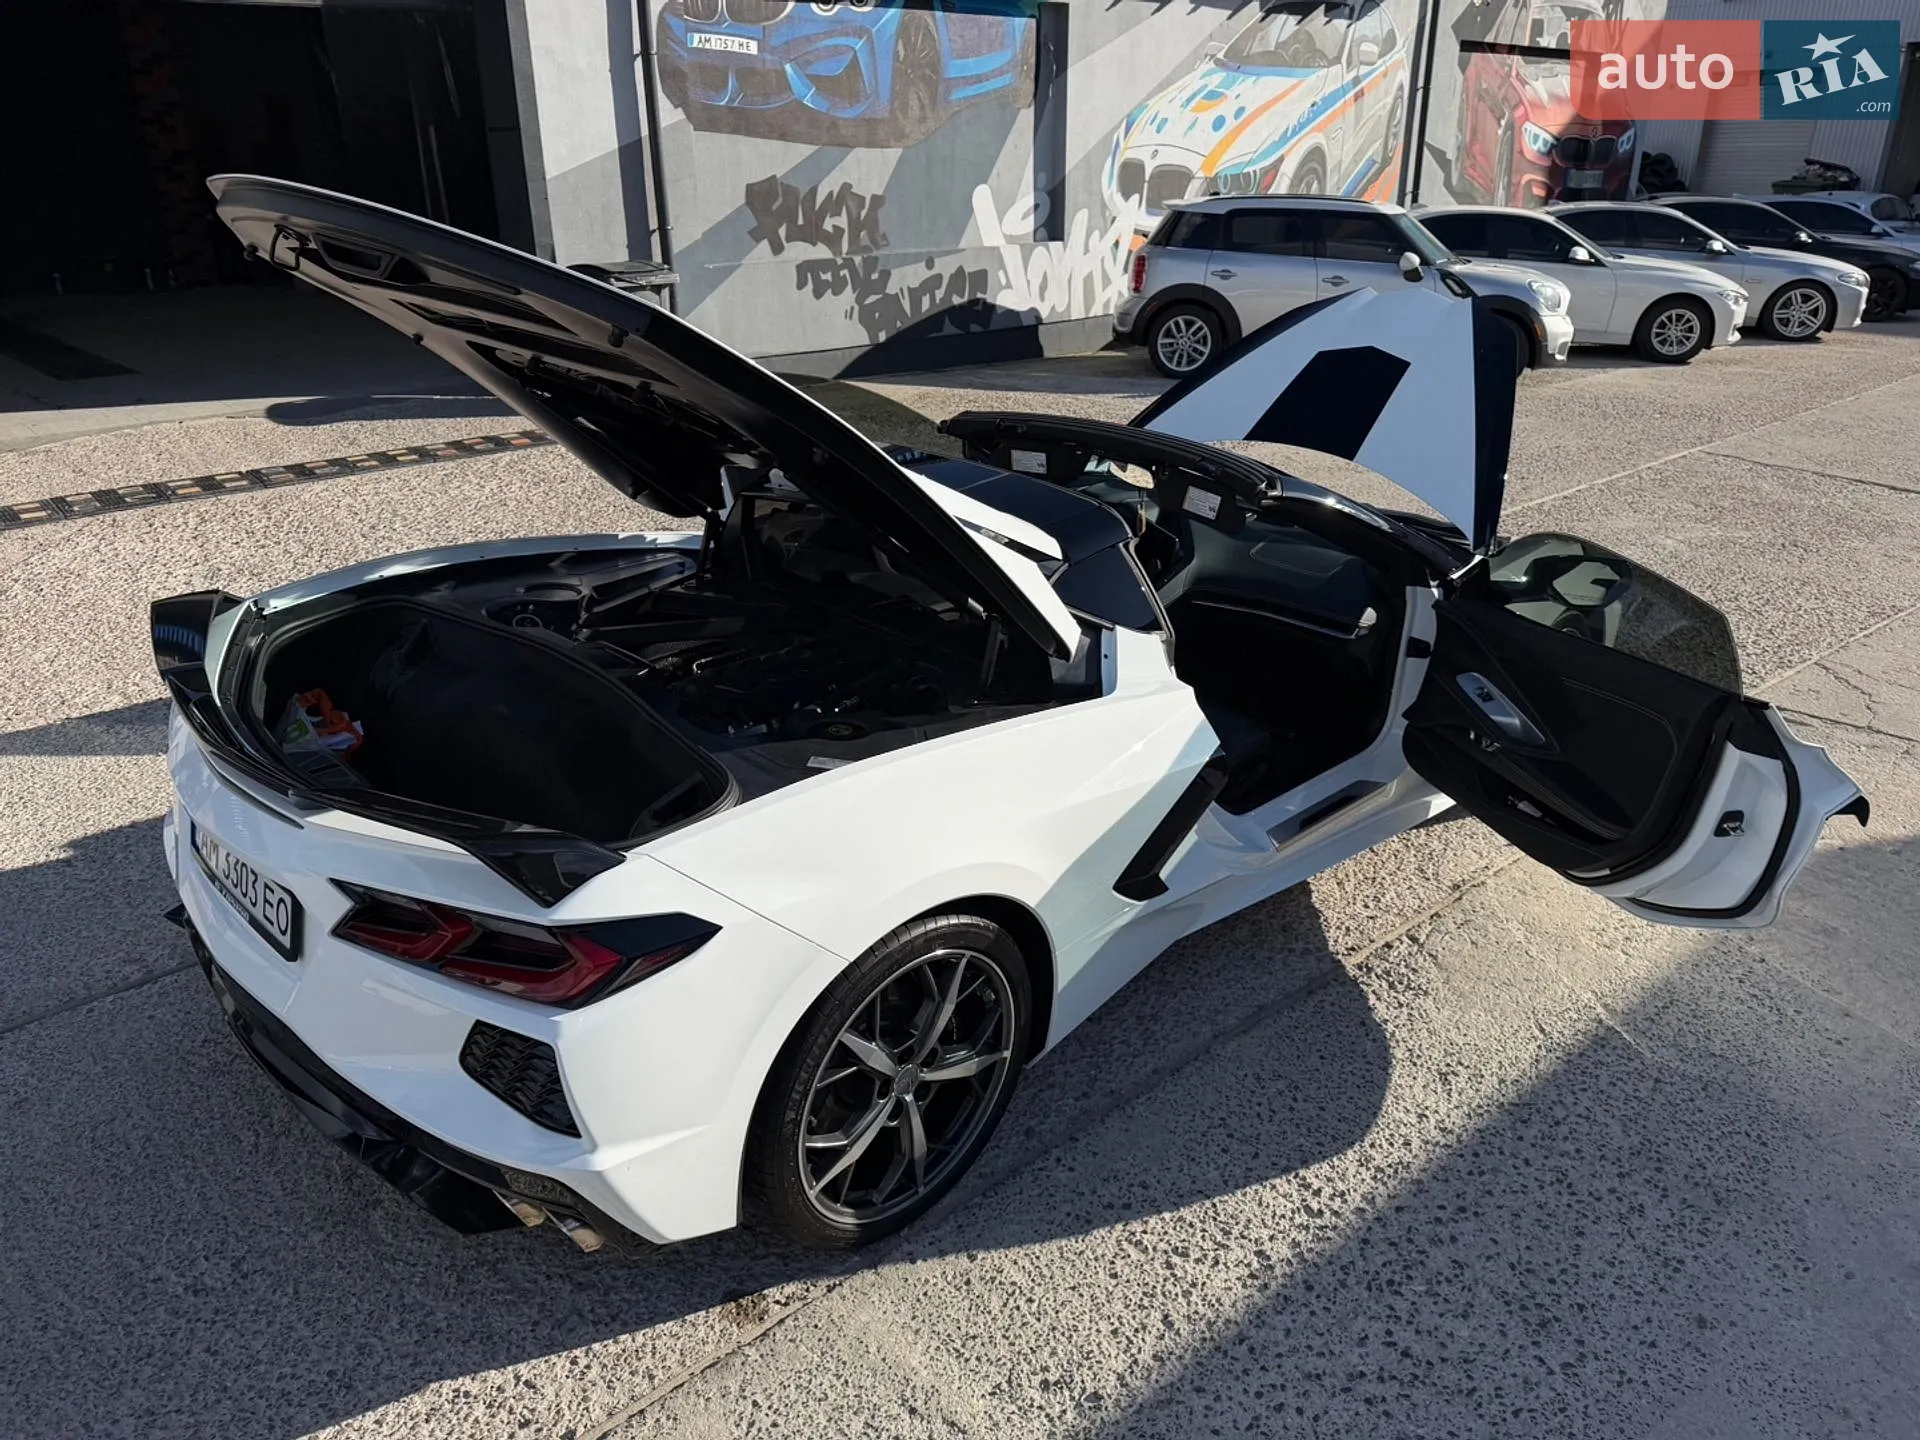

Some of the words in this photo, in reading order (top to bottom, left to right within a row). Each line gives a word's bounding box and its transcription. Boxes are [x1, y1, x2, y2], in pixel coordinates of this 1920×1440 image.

[697, 35, 712, 48] AM
[738, 40, 752, 52] HE
[262, 881, 289, 936] EO
